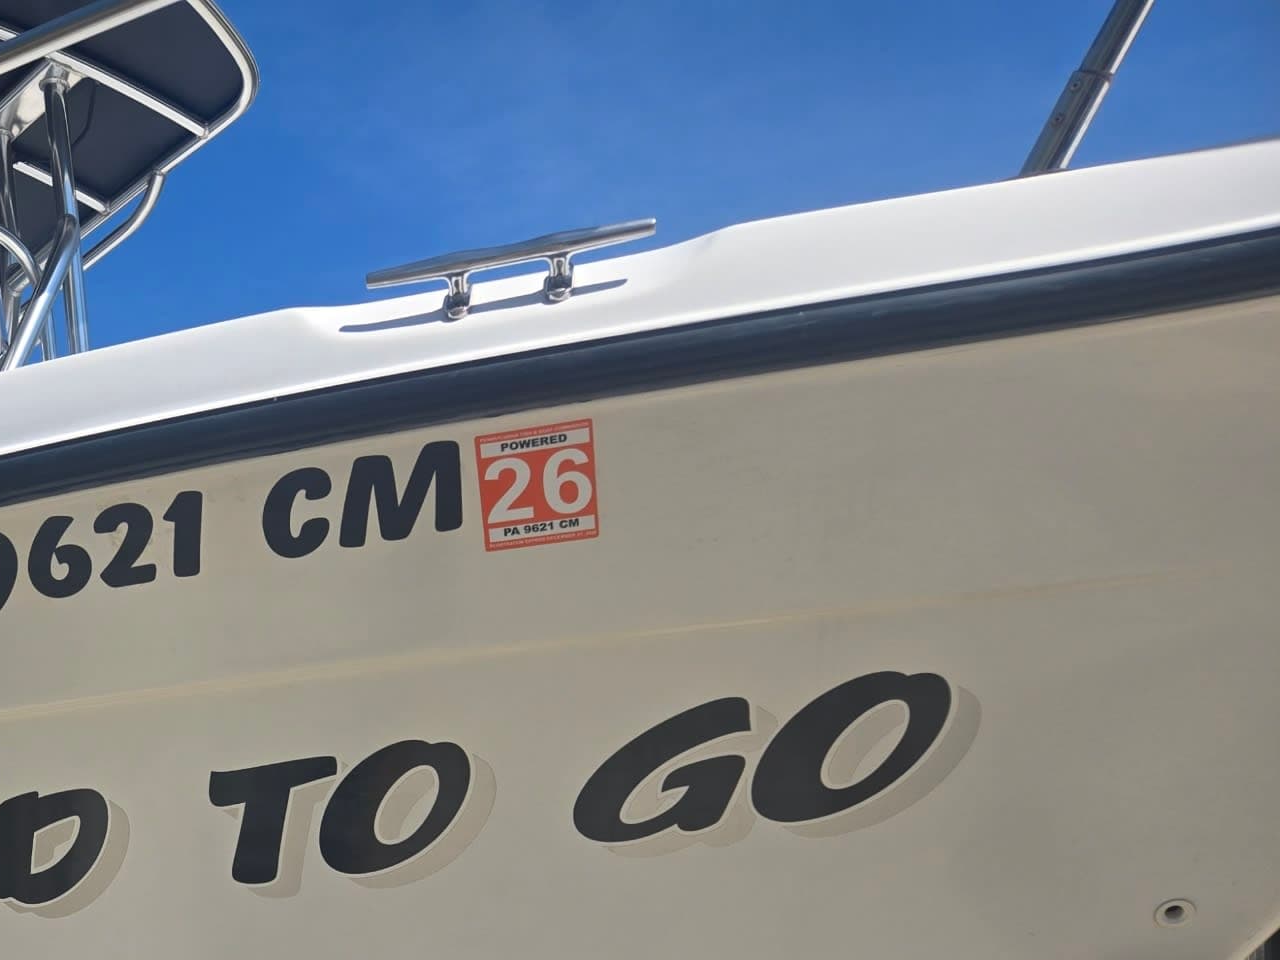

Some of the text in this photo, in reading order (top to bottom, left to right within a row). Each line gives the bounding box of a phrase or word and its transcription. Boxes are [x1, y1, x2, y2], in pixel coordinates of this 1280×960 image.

[500, 433, 568, 452] POWERED
[262, 441, 464, 559] CM
[484, 448, 592, 524] 26
[504, 518, 580, 536] PA 9621 CM
[208, 738, 476, 888] TO
[572, 670, 956, 846] GO
